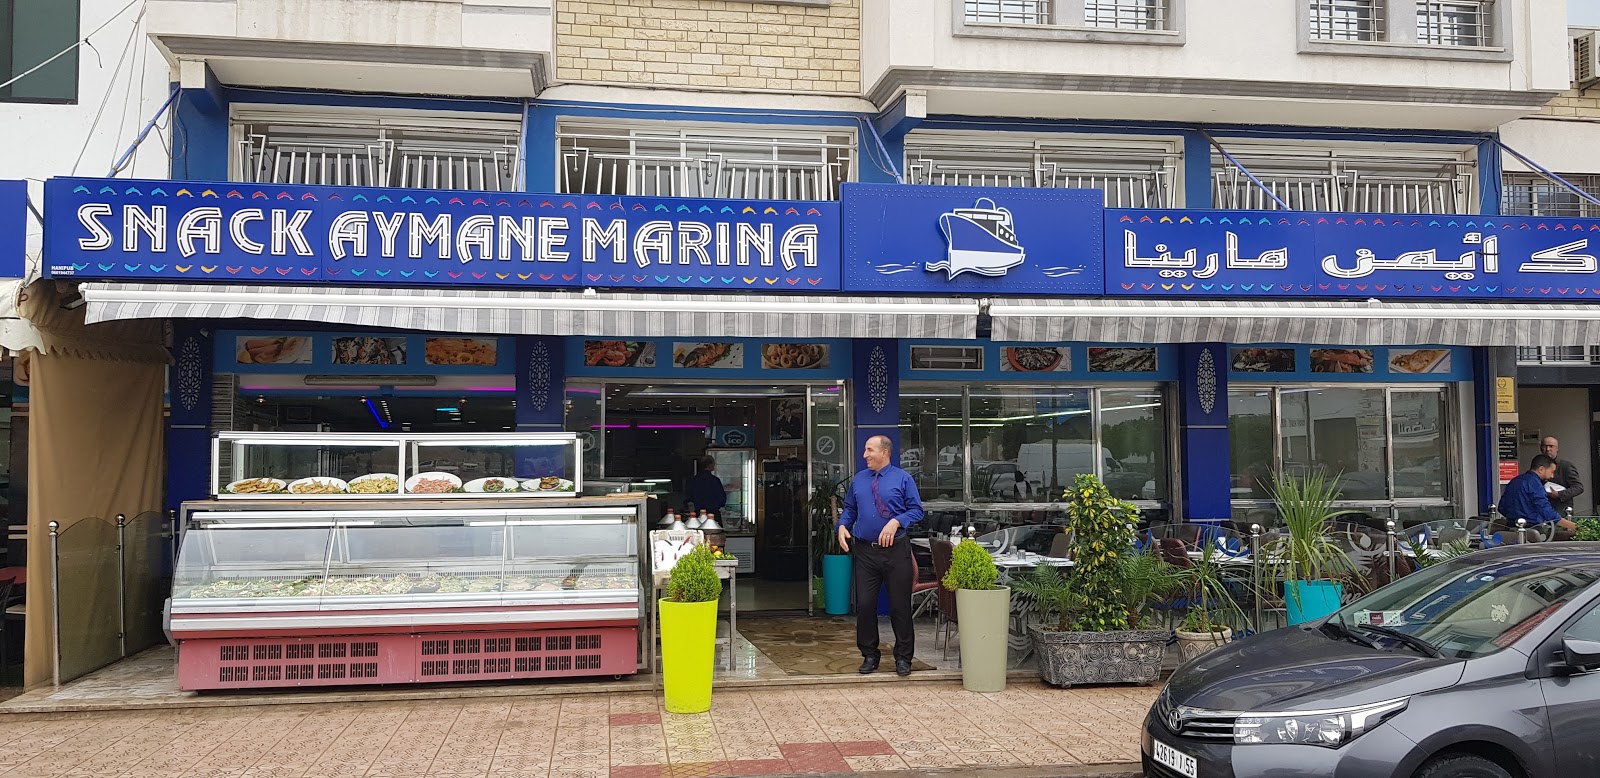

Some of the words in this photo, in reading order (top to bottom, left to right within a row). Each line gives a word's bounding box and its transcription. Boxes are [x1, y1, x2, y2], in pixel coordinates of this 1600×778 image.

[77, 203, 315, 258] SNACK
[328, 210, 571, 265] AYMANE
[582, 216, 819, 271] MARINA
[1123, 229, 1288, 279] مارينا
[1156, 743, 1175, 767] 42619
[1185, 757, 1195, 776] 55
